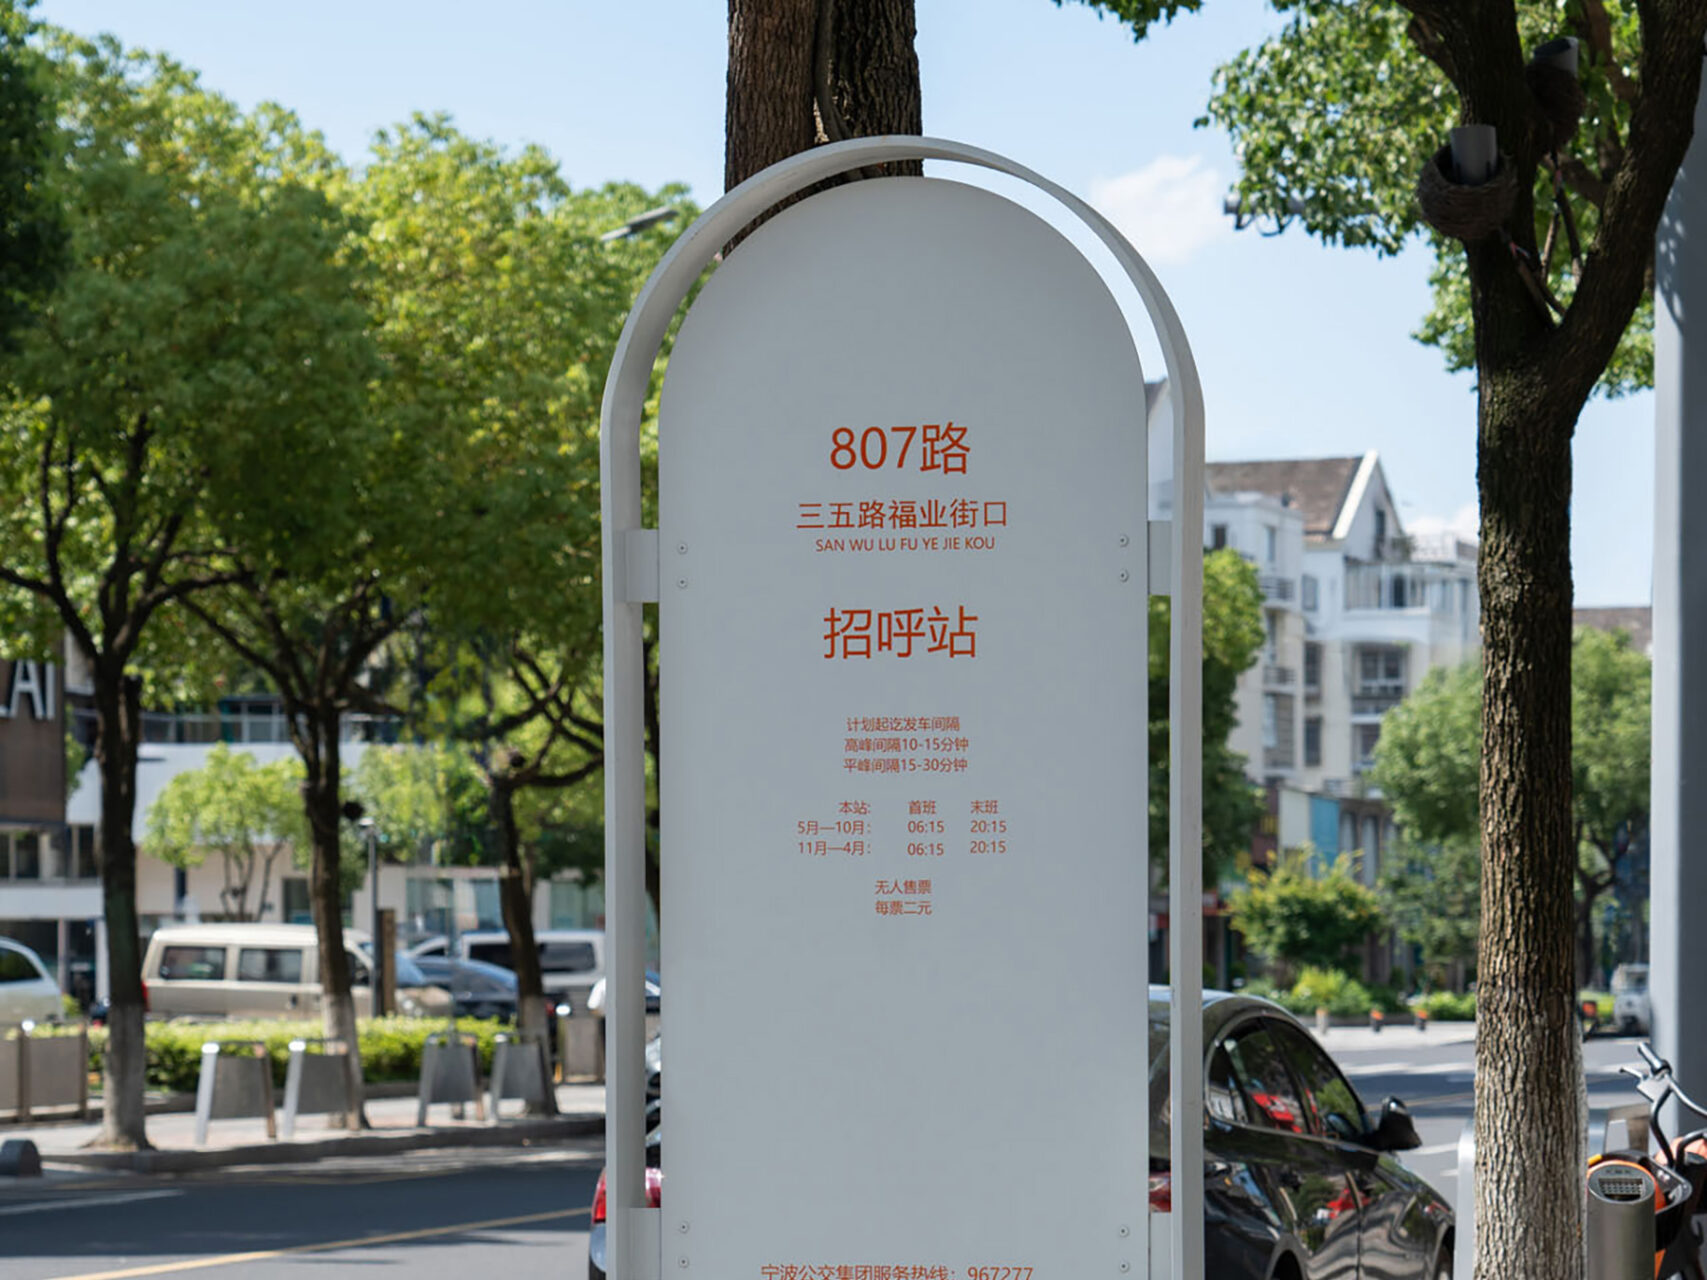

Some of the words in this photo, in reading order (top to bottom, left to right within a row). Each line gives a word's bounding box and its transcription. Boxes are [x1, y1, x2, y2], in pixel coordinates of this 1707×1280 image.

[829, 420, 971, 475] 807路
[796, 498, 1007, 530] 三五路福业街口
[816, 538, 845, 552] SAN
[849, 539, 874, 552] WU
[878, 538, 896, 552] LU
[900, 537, 918, 551] FU
[922, 537, 938, 552] YE
[942, 536, 961, 551] JIE
[964, 536, 995, 550] KOU
[824, 605, 979, 660] 招呼站
[847, 716, 960, 732] 计划起讫发车间隔
[844, 736, 968, 753] 高峰间隔10-15分钟
[843, 758, 968, 773] 平峰间隔15-30分钟
[909, 800, 936, 815] 首班
[970, 800, 999, 815] 末班
[907, 820, 944, 834] 06:15
[971, 820, 1007, 833] 20:15
[907, 842, 944, 856] 06:15
[970, 840, 1007, 853] 20:15
[875, 880, 932, 895] 无人售票
[875, 900, 932, 916] 每票二元
